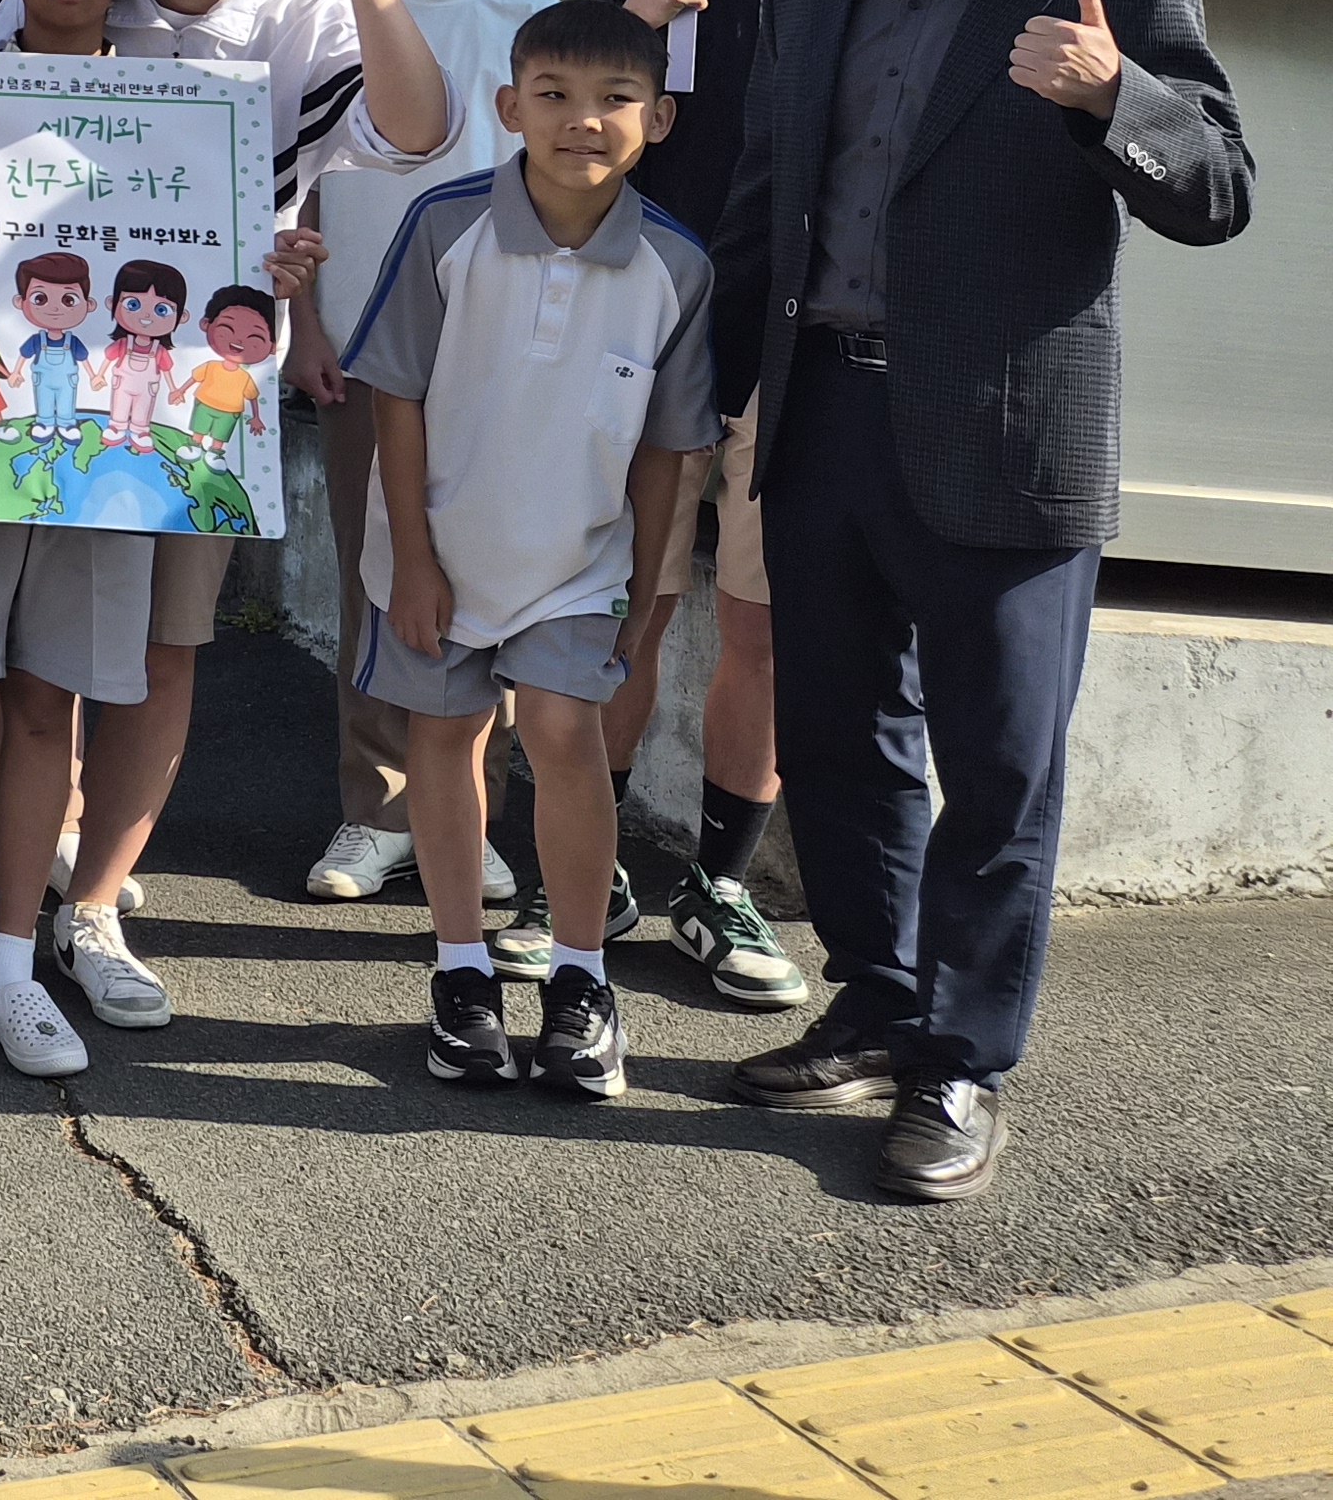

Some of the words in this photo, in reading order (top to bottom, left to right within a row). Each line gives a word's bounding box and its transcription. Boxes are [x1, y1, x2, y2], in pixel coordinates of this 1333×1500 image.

[36, 114, 152, 145] 세계와
[6, 157, 113, 202] 친구되는
[127, 165, 191, 203] 하루
[54, 223, 120, 252] 문화를
[128, 227, 222, 246] 배워봐요
